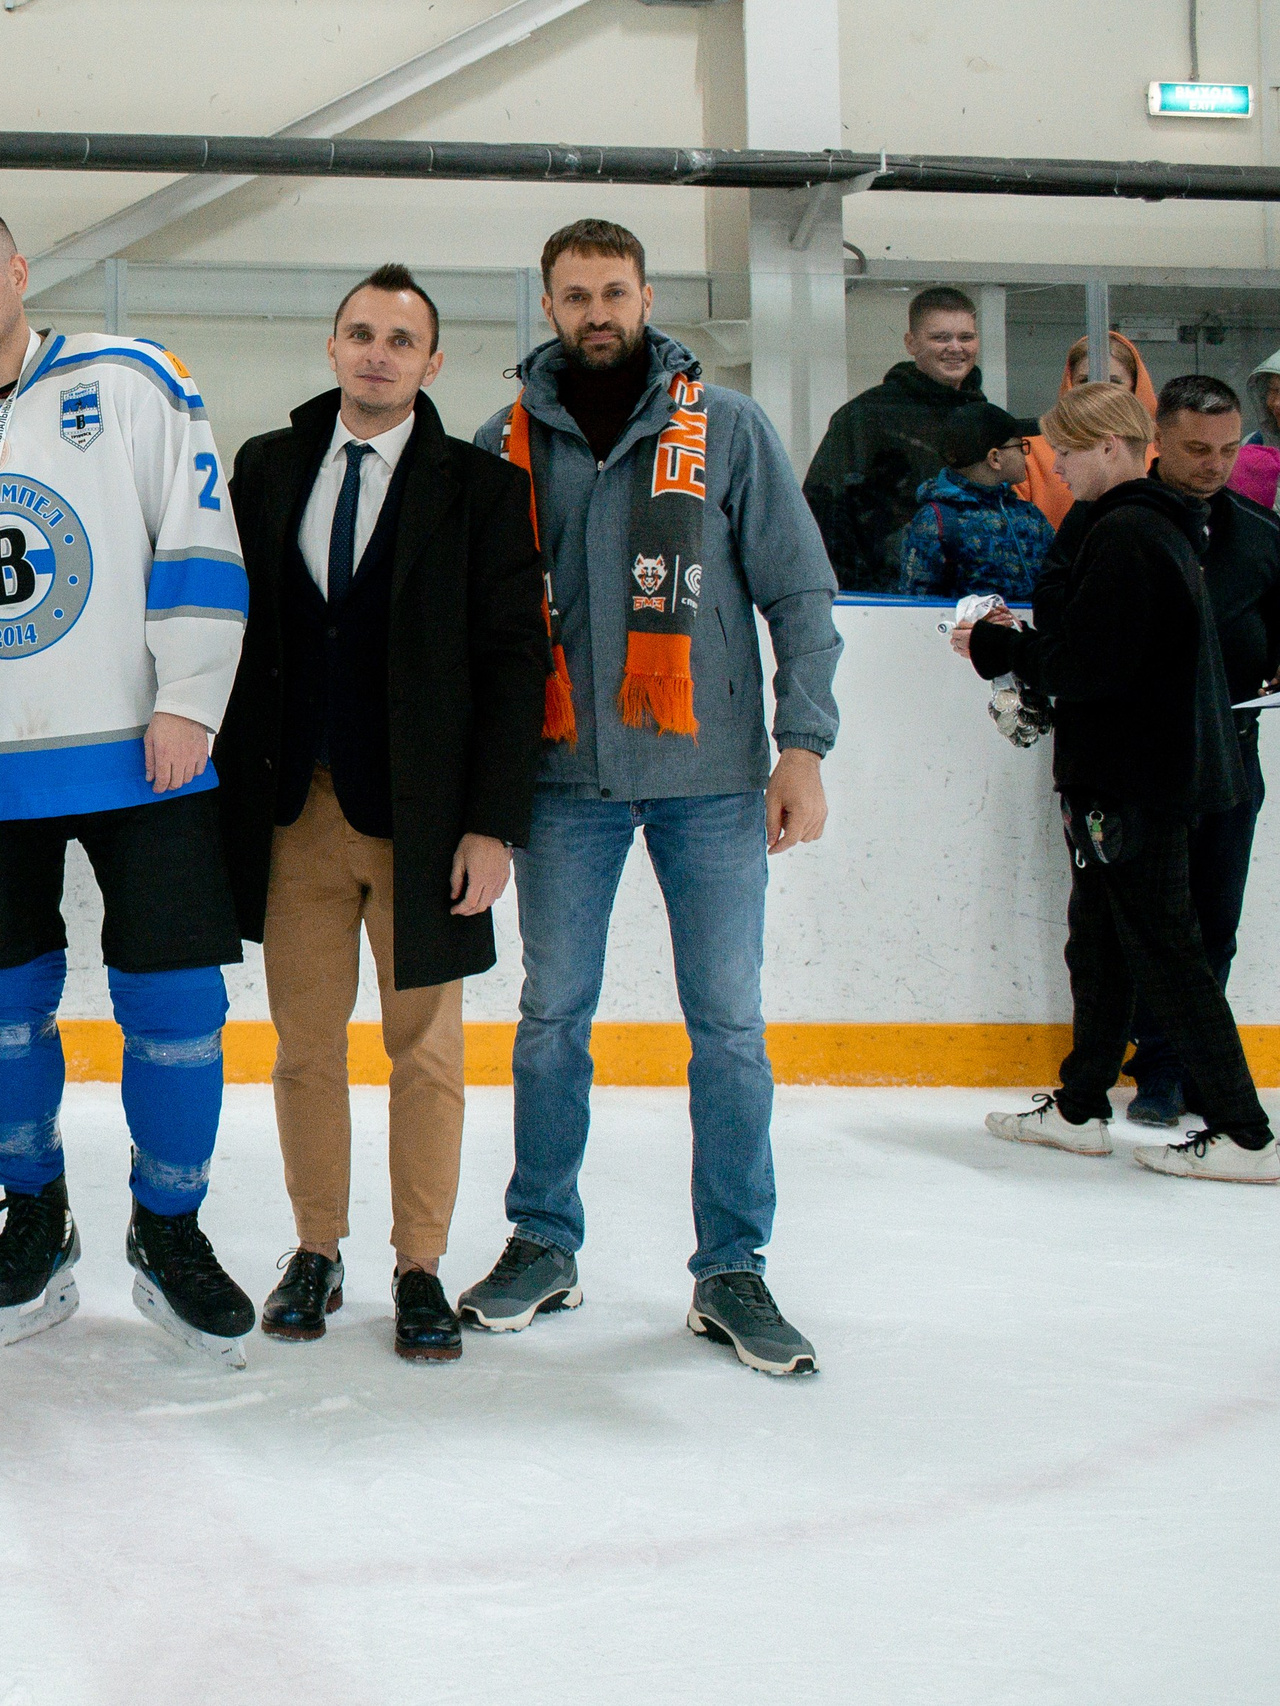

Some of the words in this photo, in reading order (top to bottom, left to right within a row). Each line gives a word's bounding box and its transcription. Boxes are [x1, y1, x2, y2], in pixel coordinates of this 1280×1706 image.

[1175, 86, 1234, 101] ВЫХОД
[1189, 101, 1216, 110] EXIT
[195, 452, 221, 511] 2
